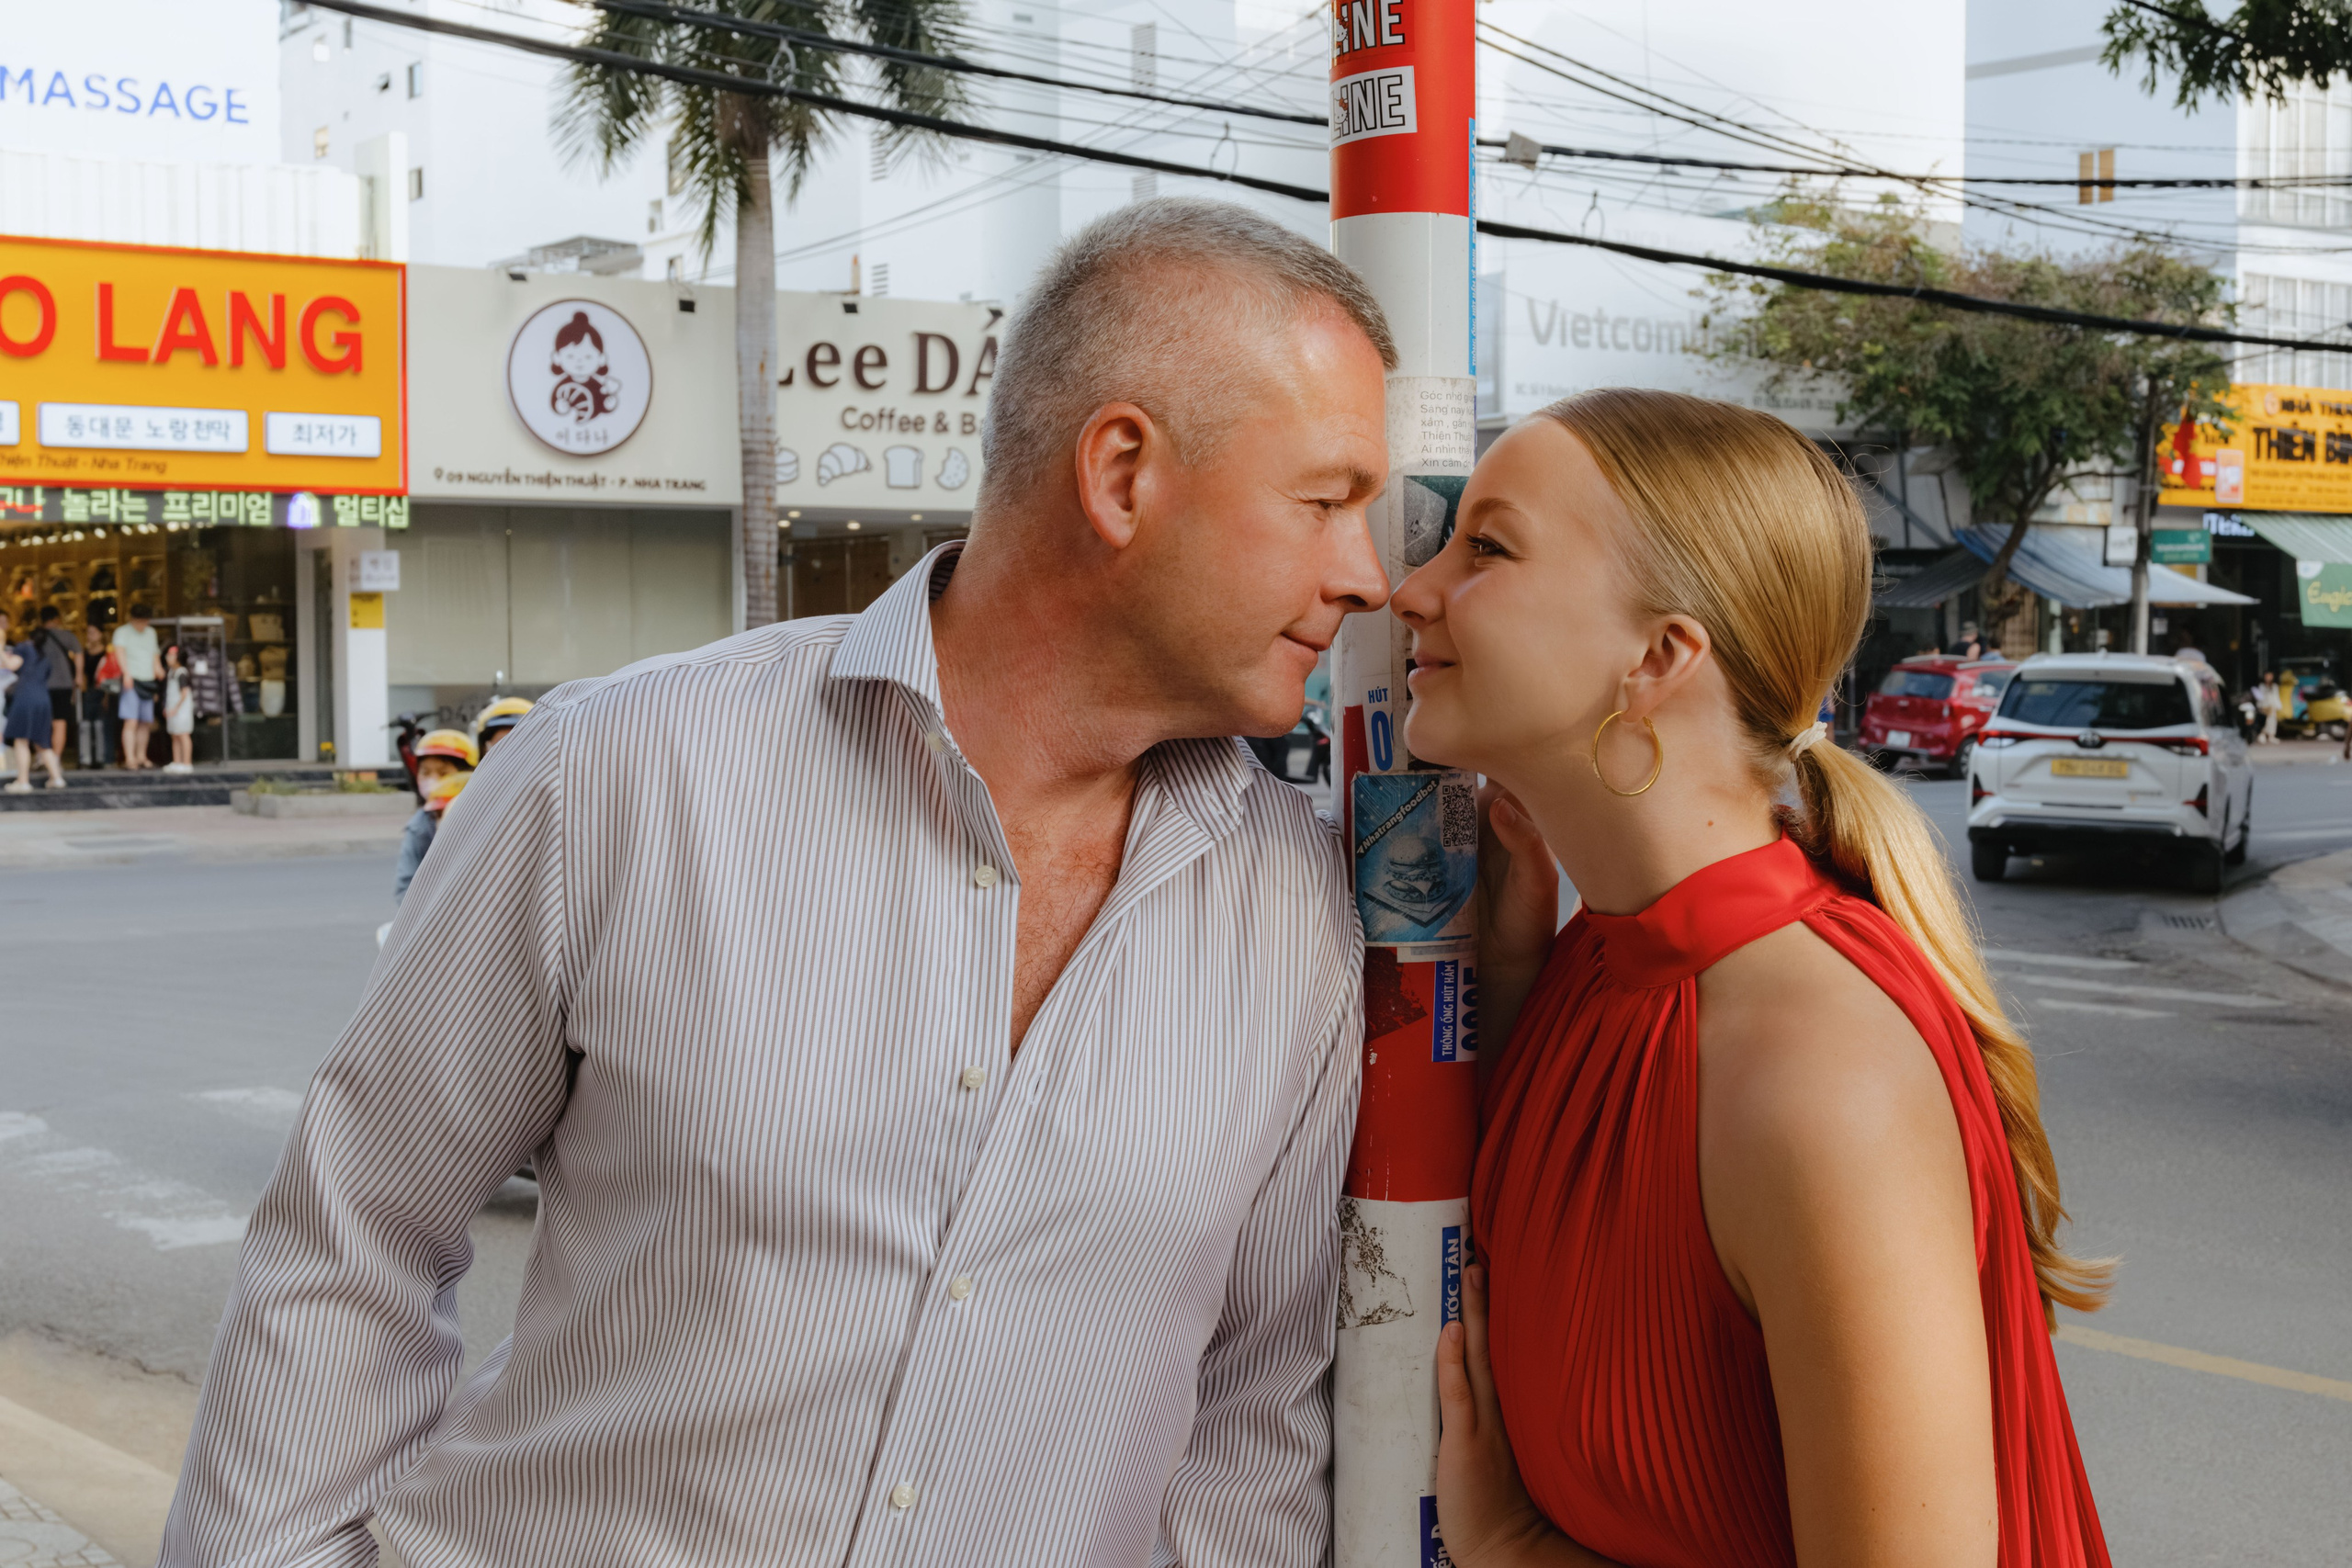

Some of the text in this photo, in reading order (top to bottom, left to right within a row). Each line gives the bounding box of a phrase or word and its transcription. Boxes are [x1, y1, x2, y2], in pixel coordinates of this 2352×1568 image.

[0, 65, 249, 124] MASSAGE
[95, 279, 363, 375] LANG
[1419, 390, 1442, 400] Góc
[67, 415, 133, 439] 동대문
[841, 406, 926, 432] Coffee
[292, 422, 357, 447] 최저가
[1421, 431, 1451, 443] Thiện
[1421, 444, 1432, 454] Ai
[126, 457, 168, 475] Trang
[1421, 457, 1440, 467] Xin
[61, 488, 149, 523] 놀라는
[162, 491, 273, 526] 프리미엄
[1368, 686, 1388, 704] HÚT
[1362, 780, 1438, 849] Nhatrangfoodbot
[1442, 985, 1454, 1002] HÚT
[1440, 1004, 1453, 1023] ỐNG
[1440, 1024, 1453, 1056] THÔNG
[1445, 1237, 1459, 1279] TÂN
